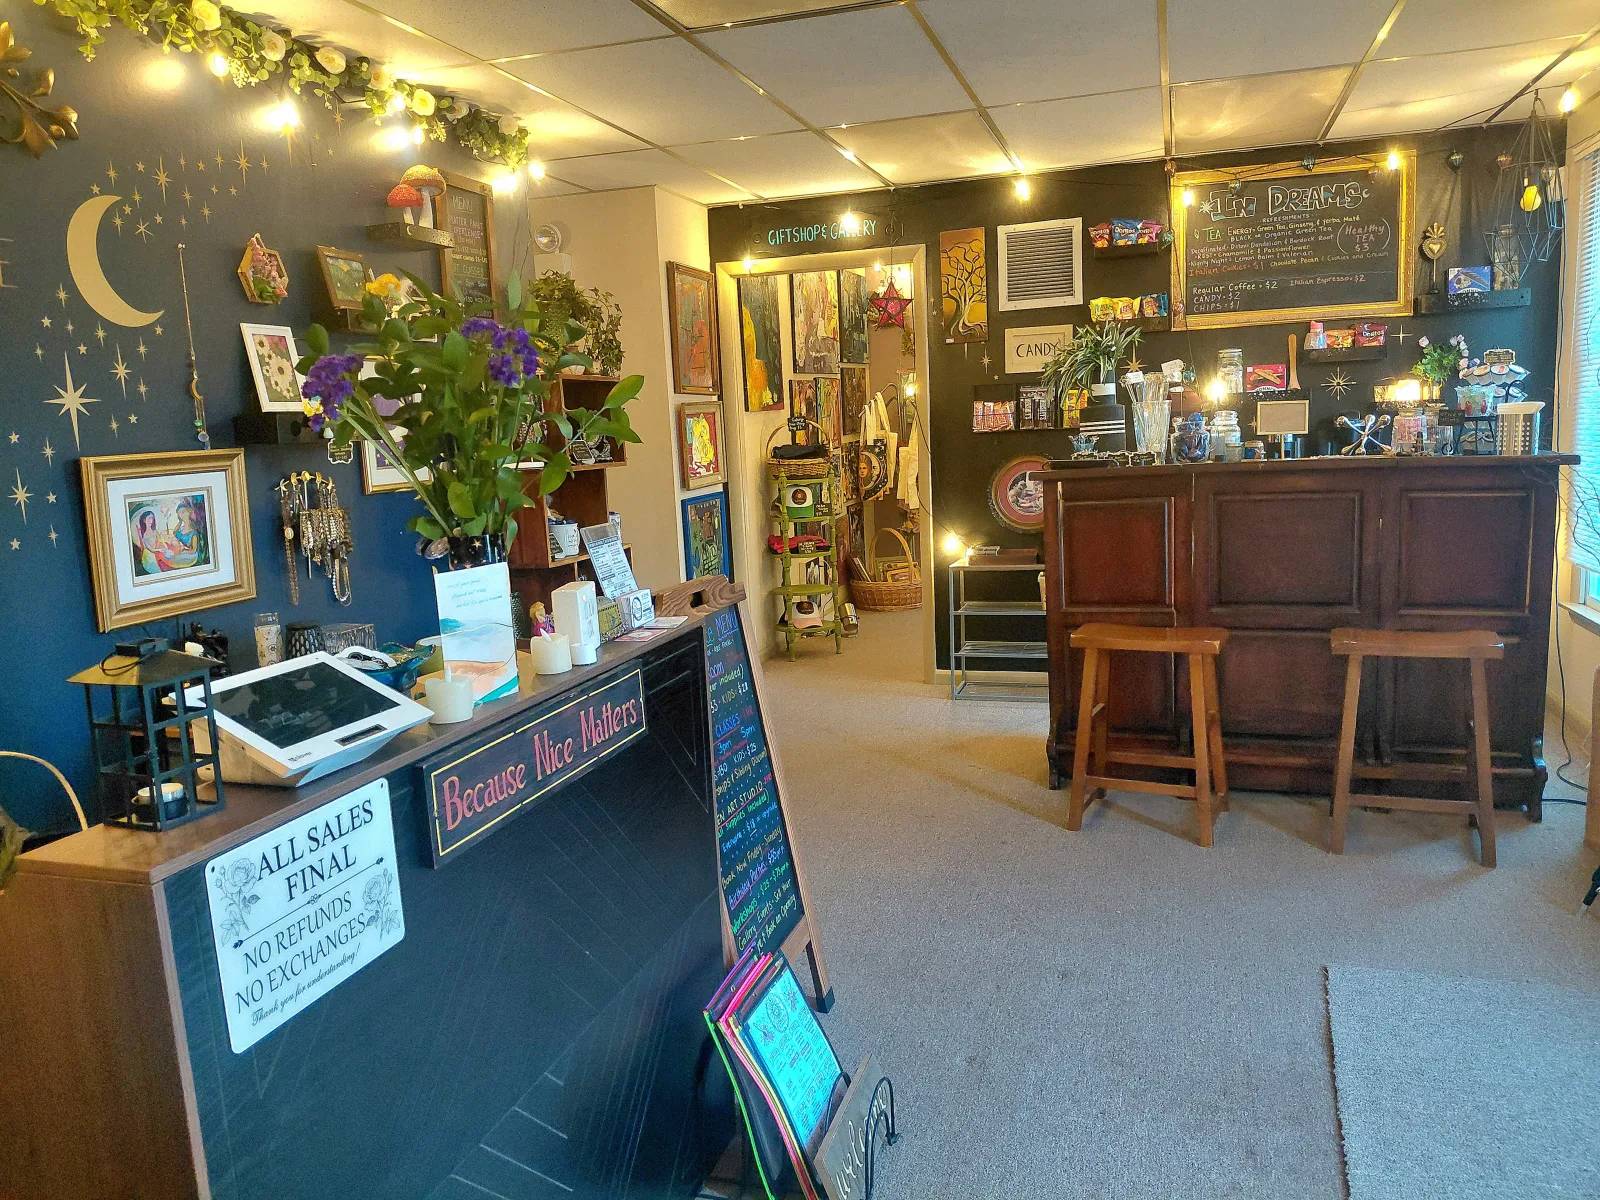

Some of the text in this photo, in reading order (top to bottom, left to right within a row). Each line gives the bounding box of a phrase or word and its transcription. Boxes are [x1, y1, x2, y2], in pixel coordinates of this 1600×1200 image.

[1267, 182, 1363, 215] DREAMS
[1114, 226, 1136, 235] Doritos
[1257, 224, 1274, 232] Green
[1264, 231, 1292, 240] Organic
[1295, 228, 1317, 236] Green
[1345, 224, 1385, 235] Healthy
[1355, 234, 1375, 242] TEA
[1250, 239, 1281, 248] Dandelion
[1354, 243, 1370, 253] $3
[1188, 267, 1219, 277] Italian
[1269, 259, 1297, 267] Chocolate
[1327, 254, 1350, 262] Cookies
[1366, 251, 1389, 259] Cream
[1192, 286, 1225, 297] Regular
[1228, 281, 1256, 291] Coffee
[1265, 280, 1278, 290] $2
[1289, 278, 1315, 287] Italian
[1354, 274, 1366, 283] $2
[1193, 303, 1222, 313] CHIPS
[1229, 300, 1240, 310] $1
[1228, 291, 1241, 301] $2
[1361, 329, 1385, 338] Doritos
[1015, 341, 1060, 358] CANDY
[715, 611, 737, 638] MENU
[715, 713, 740, 738] CLASSES
[717, 740, 733, 754] 3pm
[740, 724, 755, 739] 5pm
[442, 699, 637, 831] Because Nice Matters
[726, 798, 739, 816] ART
[739, 780, 763, 806] STUDIO
[257, 799, 374, 882] ALL SALES
[286, 844, 357, 902] FINAL
[731, 898, 759, 934] Workshops
[243, 891, 353, 975] NO REFUNDS
[738, 925, 758, 951] Gallery
[235, 912, 367, 1014] NO EXCHANGES
[251, 942, 361, 1027] Thank you for understanding!
